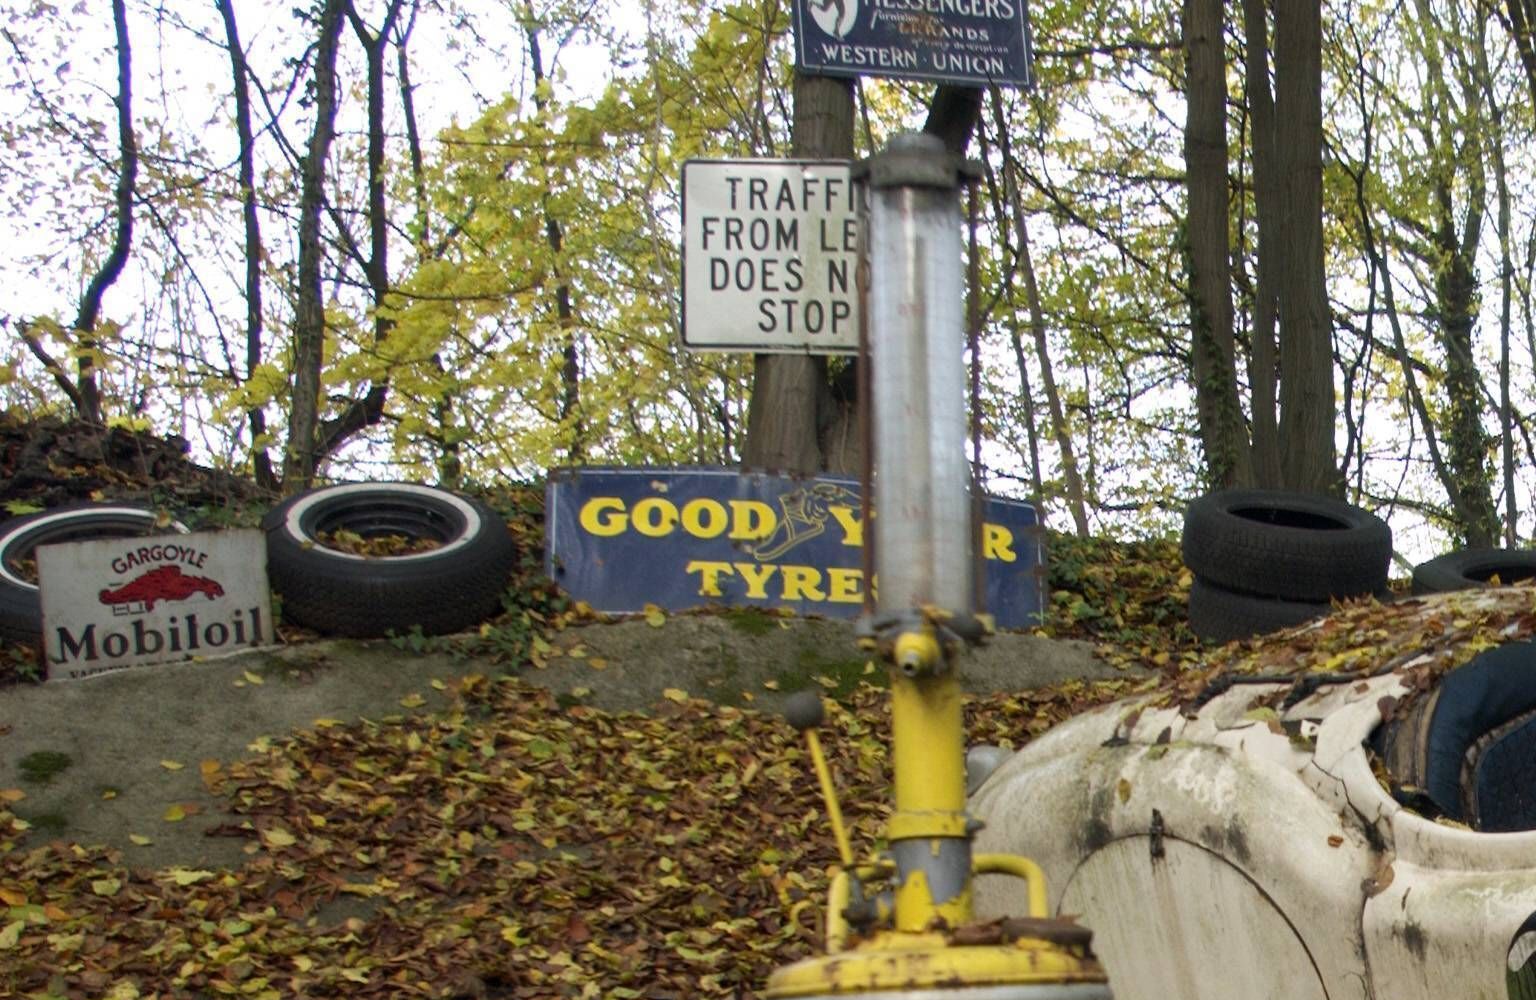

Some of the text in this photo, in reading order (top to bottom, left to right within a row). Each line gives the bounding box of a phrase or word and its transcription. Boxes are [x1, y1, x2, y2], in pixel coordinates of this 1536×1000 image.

[821, 43, 918, 68] WESTERN
[932, 53, 1005, 75] UNION
[725, 177, 871, 212] TRAFFI
[702, 217, 799, 251] FROM
[710, 257, 803, 292] DOES
[758, 298, 850, 333] STOP
[112, 544, 208, 574] GARGOYLE
[686, 561, 878, 603] TYRE
[51, 607, 264, 665] Mobiloil
